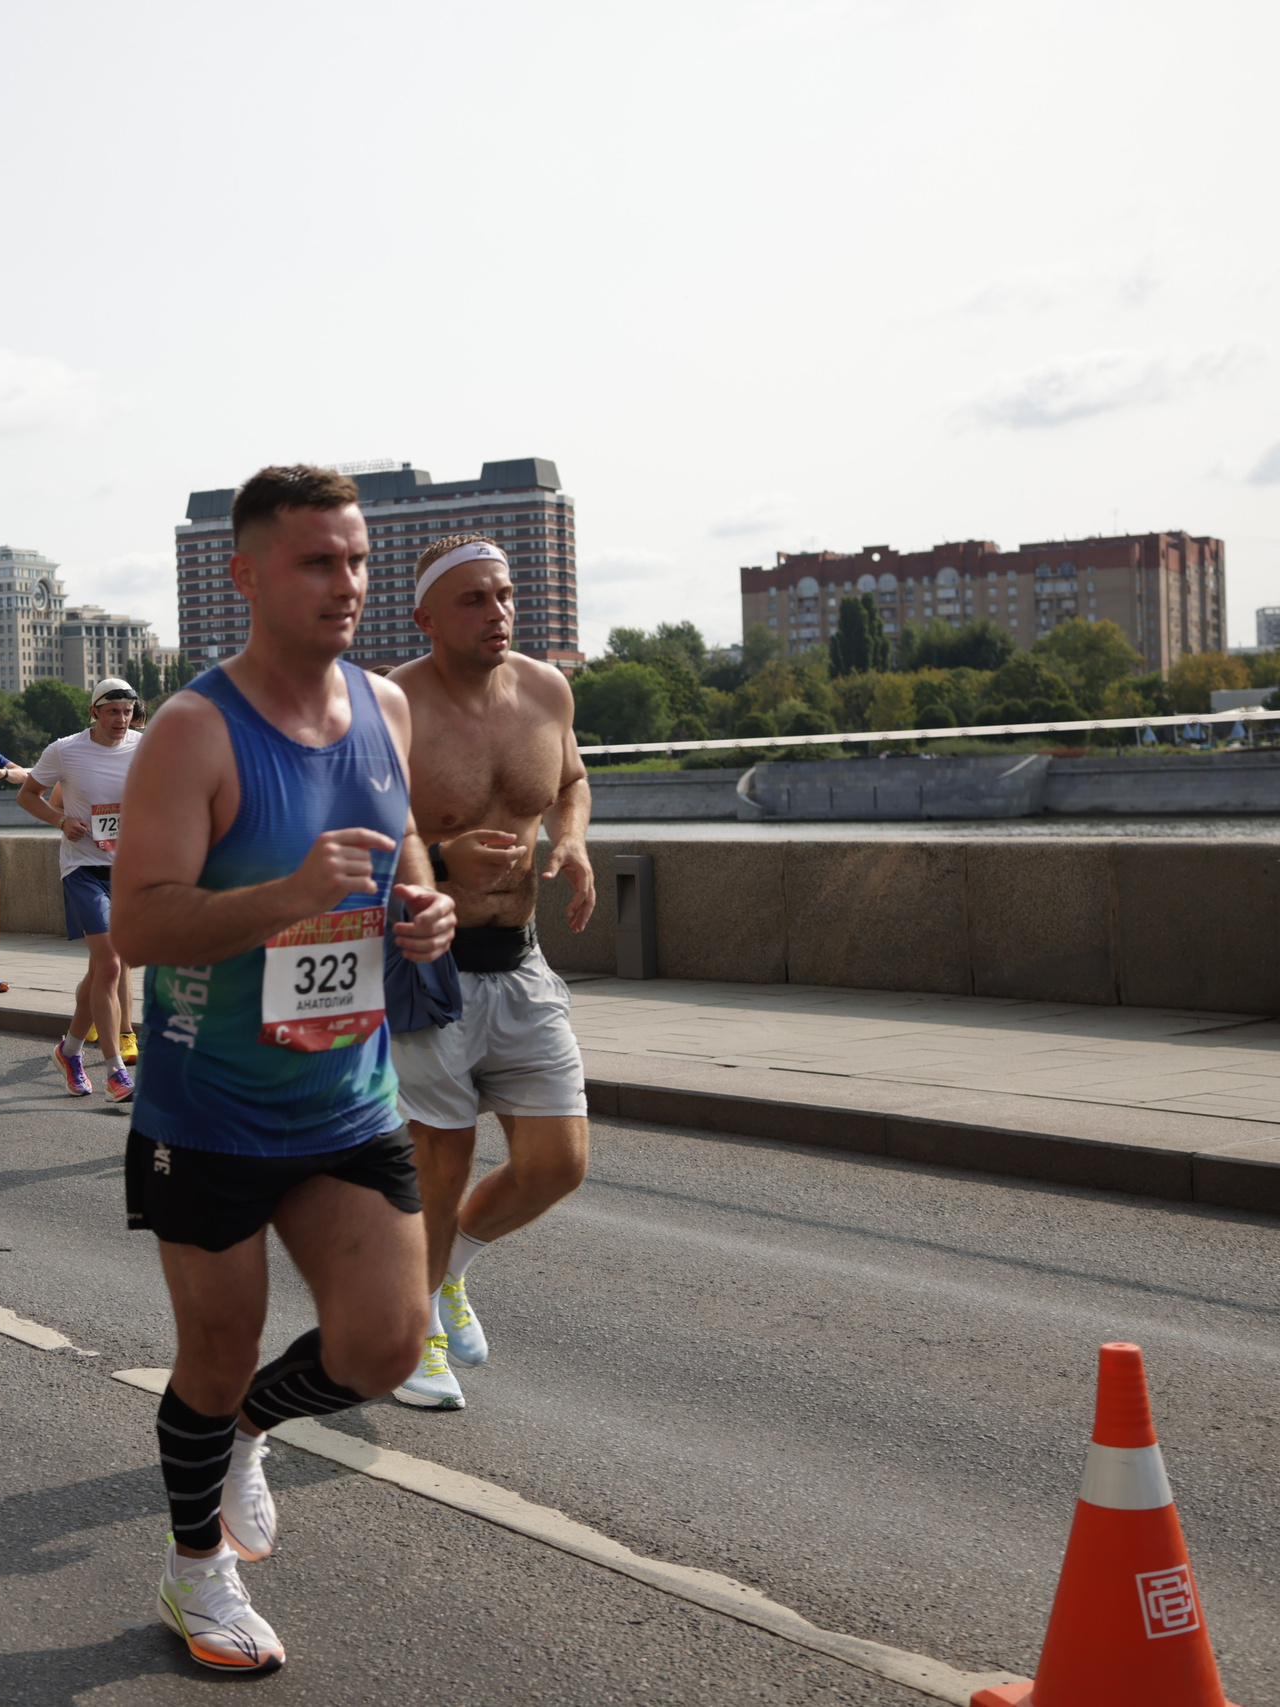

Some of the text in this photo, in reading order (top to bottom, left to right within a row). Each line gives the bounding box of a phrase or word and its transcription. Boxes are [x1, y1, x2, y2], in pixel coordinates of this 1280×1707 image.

[294, 952, 358, 995] 323
[296, 993, 354, 1011] АНАТОЛИЙ
[275, 1024, 291, 1045] C
